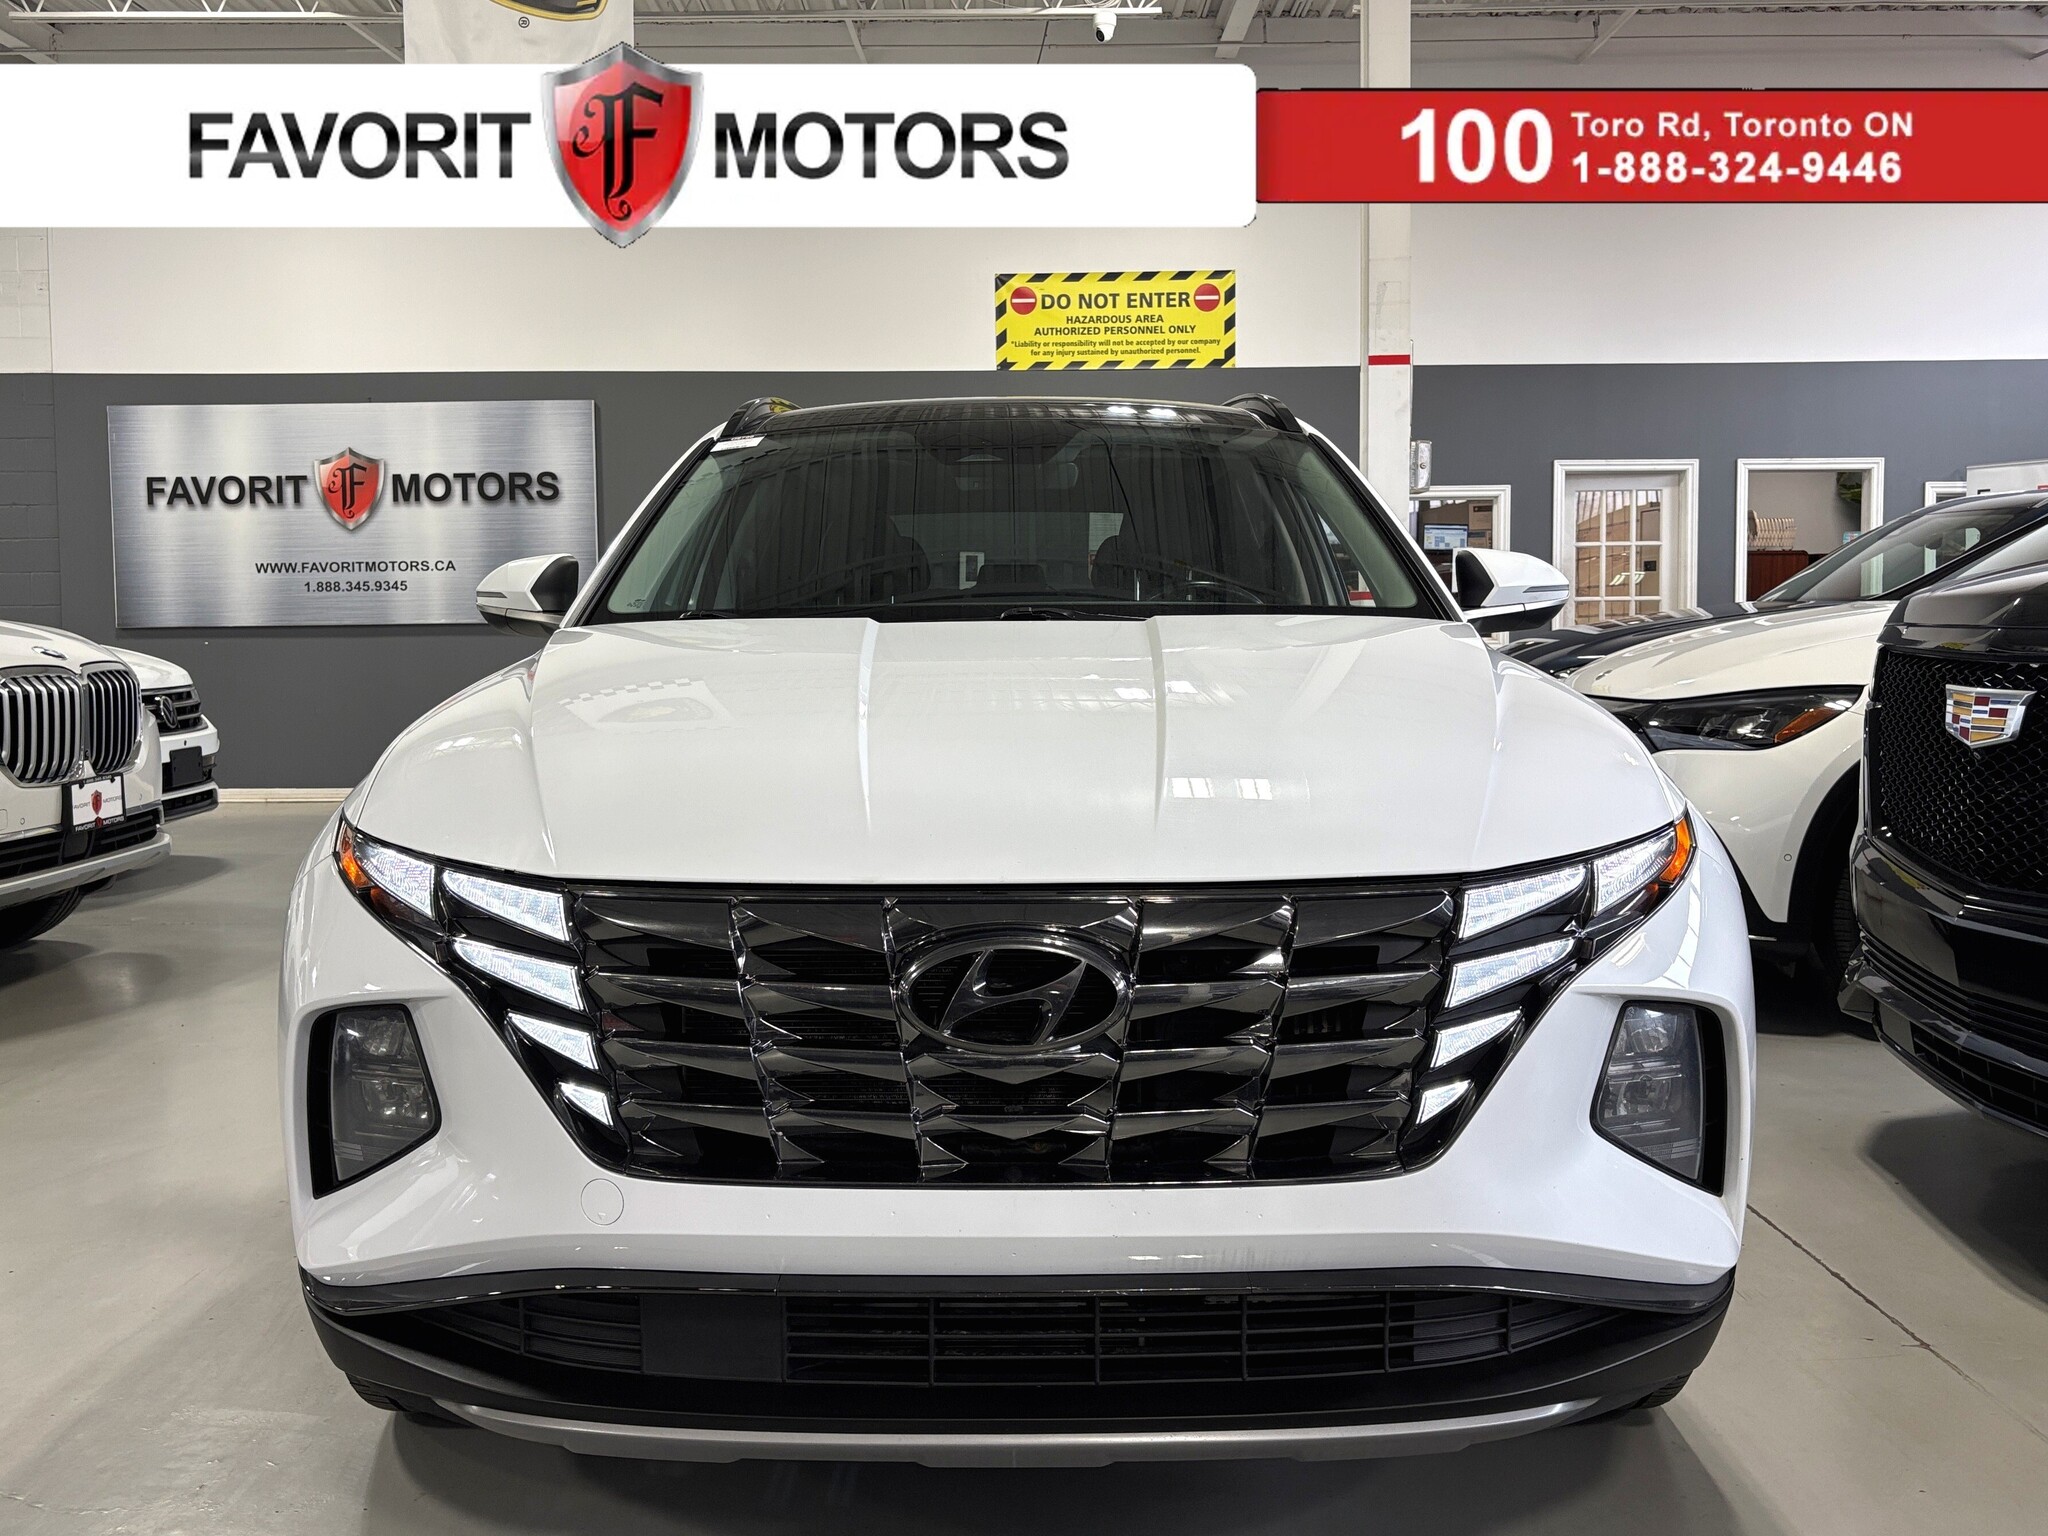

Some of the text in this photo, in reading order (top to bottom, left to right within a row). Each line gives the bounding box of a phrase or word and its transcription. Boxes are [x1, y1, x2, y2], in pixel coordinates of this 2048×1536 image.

[1041, 292, 1191, 310] DO NOT ENTER
[1066, 314, 1164, 324] HAZARDOUS AREA
[1034, 325, 1196, 336] AUTHORIZED PERSONNEL ONLY
[1052, 340, 1097, 348] responsibility
[1135, 339, 1166, 347] accepted
[1167, 339, 1176, 347] by
[1190, 339, 1221, 347] company
[1056, 349, 1075, 357] injury
[1077, 348, 1109, 356] sustained
[1110, 348, 1119, 356] by
[1120, 347, 1165, 355] unauthorized
[146, 475, 307, 505] FAVORIT
[392, 471, 560, 502] MOTORS
[255, 561, 456, 574] WWW.FAVORITMOTORS.CA
[304, 581, 408, 593] 1.888.345.9345
[75, 817, 124, 832] FAVORIT MOTORS
